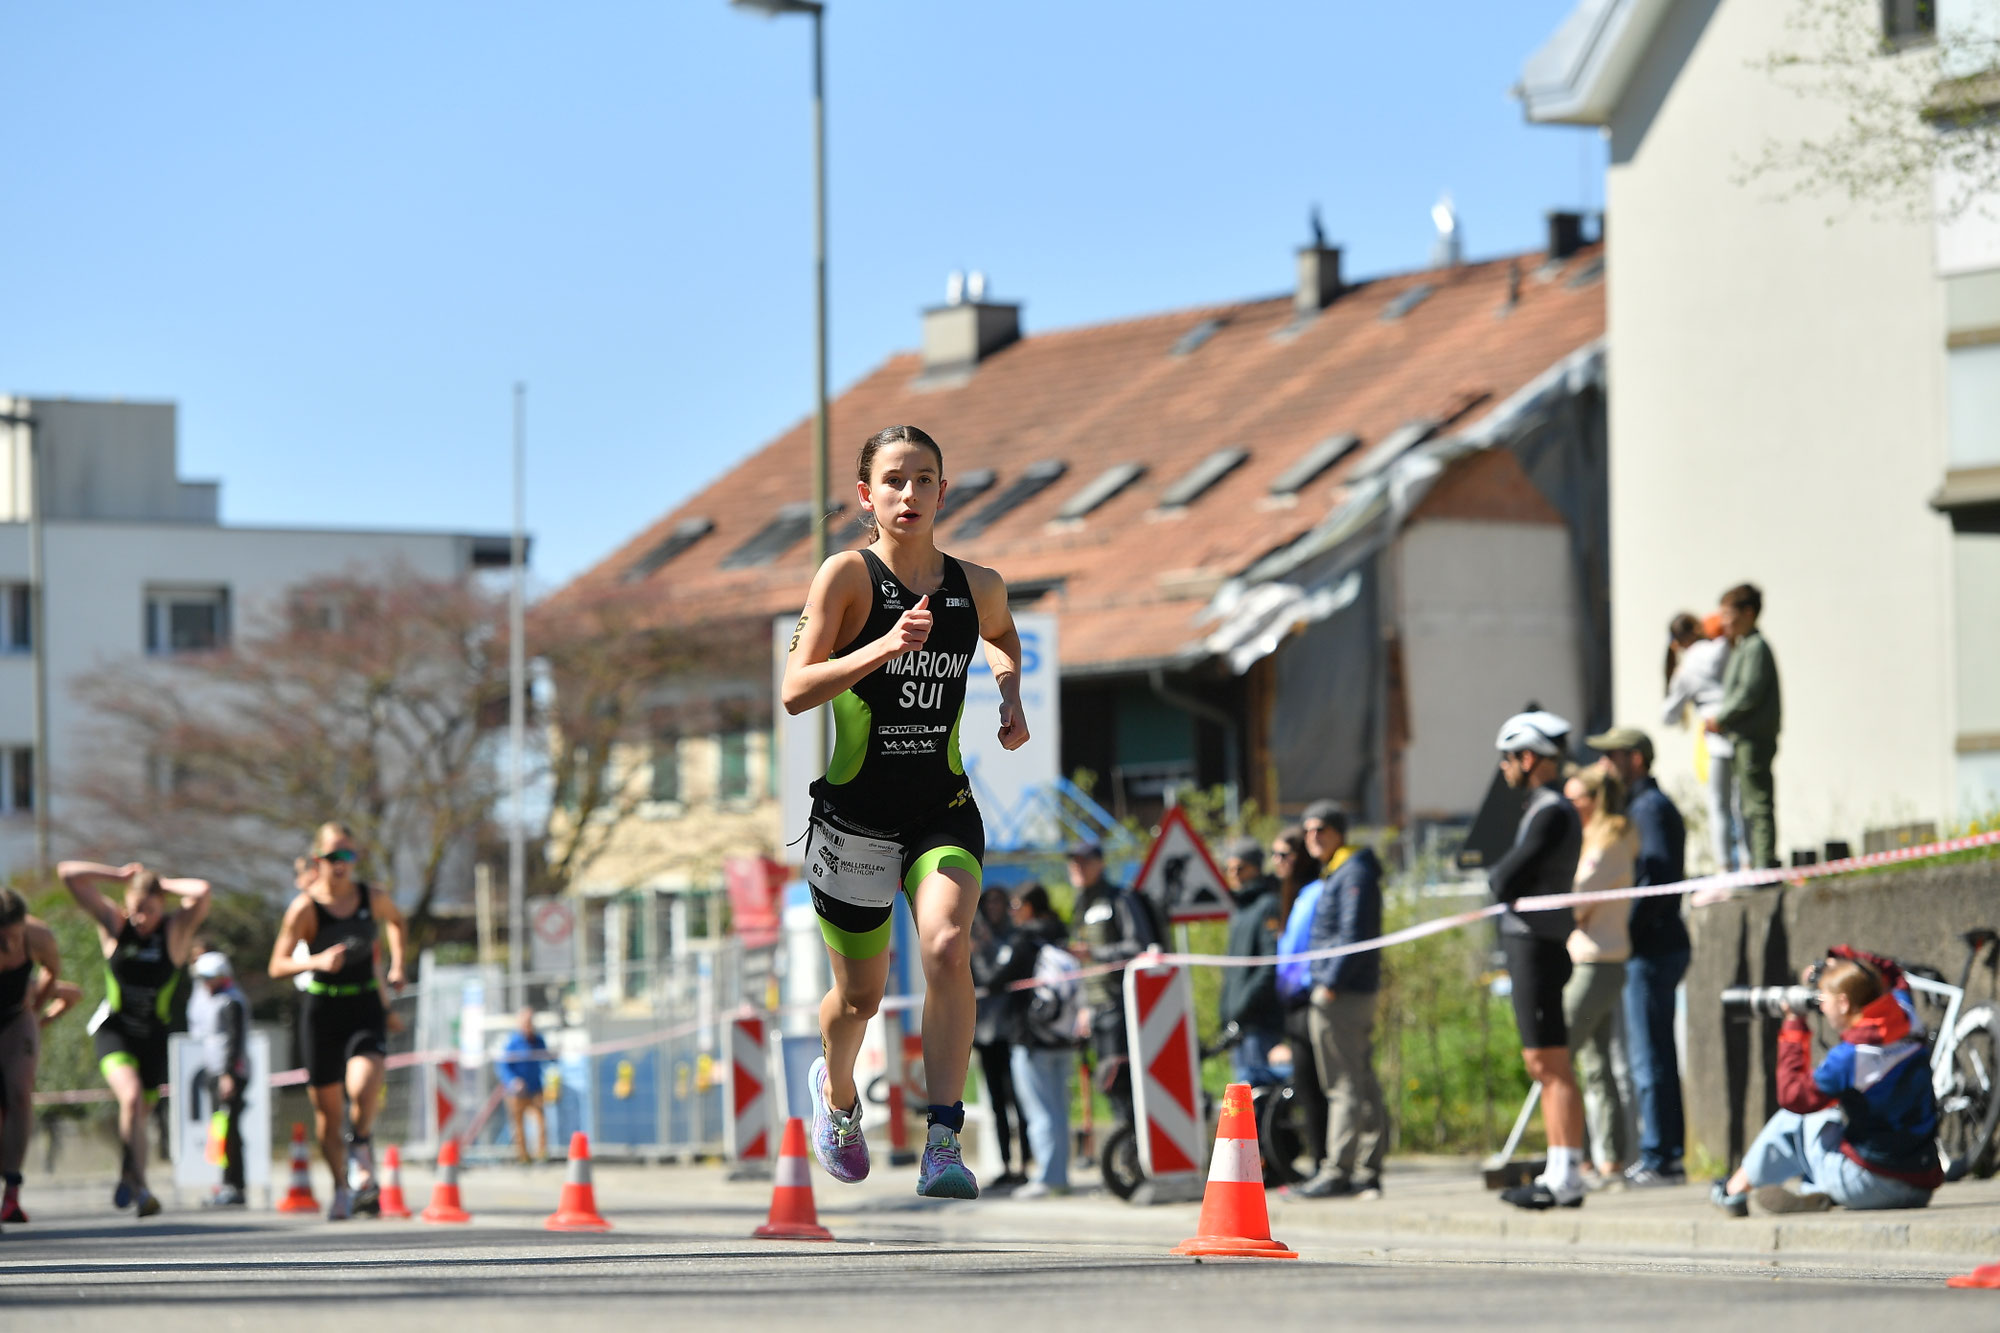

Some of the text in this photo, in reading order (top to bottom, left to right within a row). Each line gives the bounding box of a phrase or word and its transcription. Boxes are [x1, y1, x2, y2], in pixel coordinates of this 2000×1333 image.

[885, 650, 968, 678] MARIONI
[898, 681, 944, 710] SUI
[878, 724, 948, 735] POWERLAB
[812, 863, 824, 878] 63
[839, 865, 875, 876] TRIATHLON
[840, 859, 886, 872] WALLISELLEN
